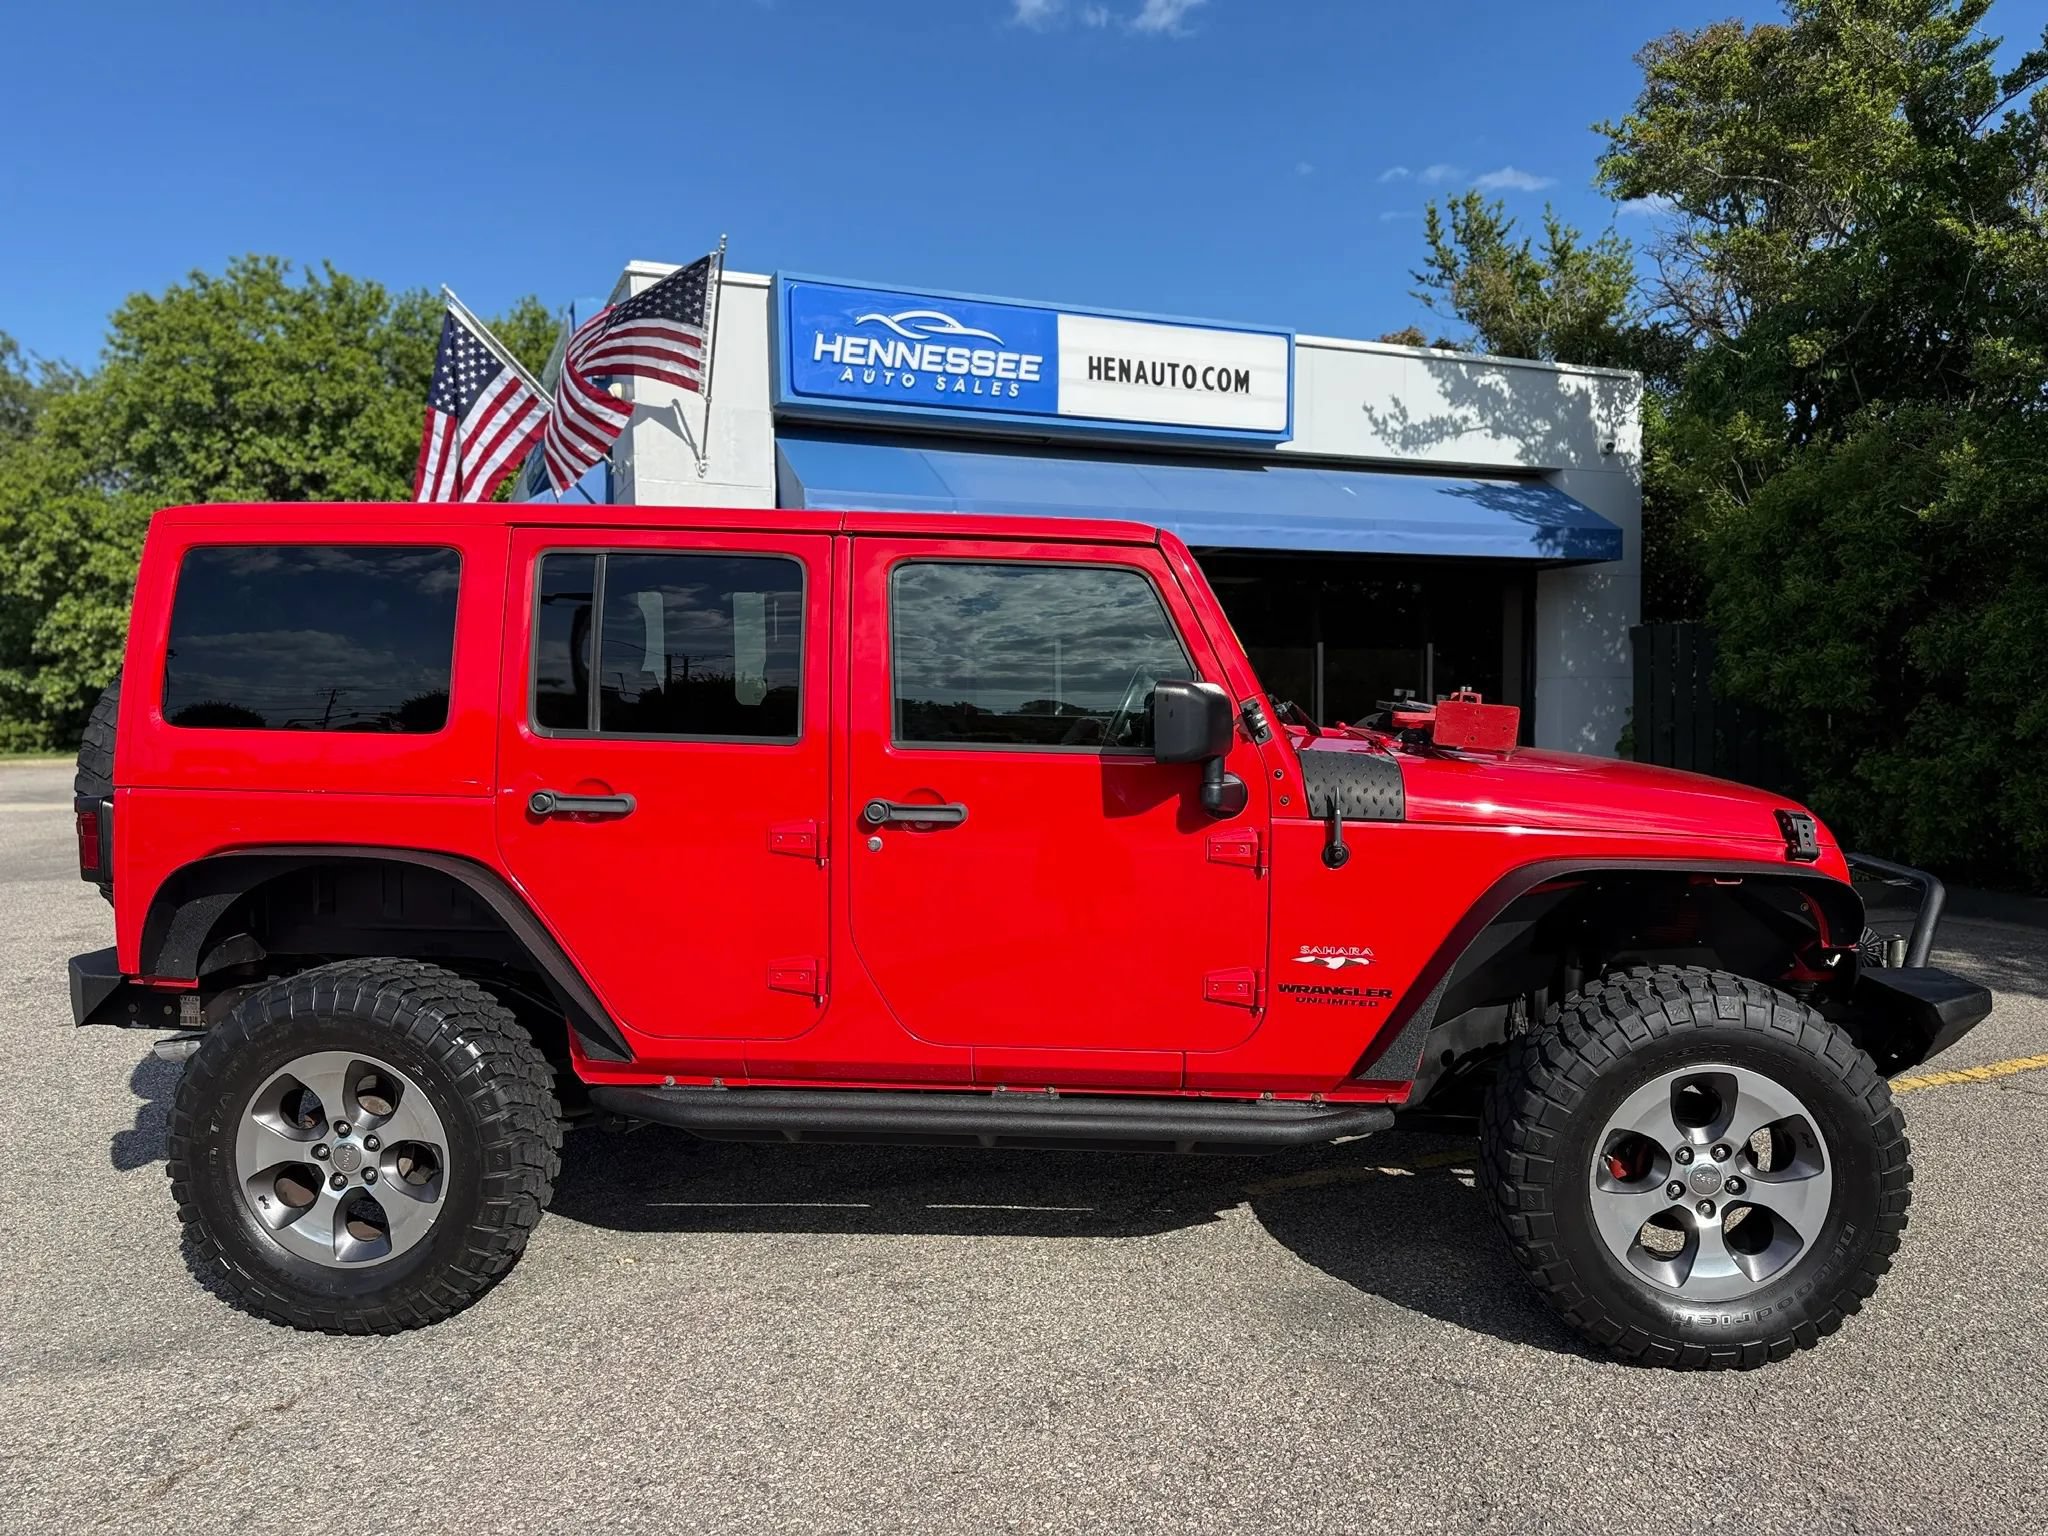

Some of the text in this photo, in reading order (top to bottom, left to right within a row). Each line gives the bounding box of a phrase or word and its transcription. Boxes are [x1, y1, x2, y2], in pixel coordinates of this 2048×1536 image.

[813, 331, 1043, 382] HENNESSEE
[840, 366, 1021, 398] AUTO SALES
[1088, 355, 1250, 394] HENAUTO.COM
[1299, 945, 1374, 956] SAHARA
[1278, 983, 1393, 999] WRANGLER
[1295, 996, 1379, 1008] UNLIMITED
